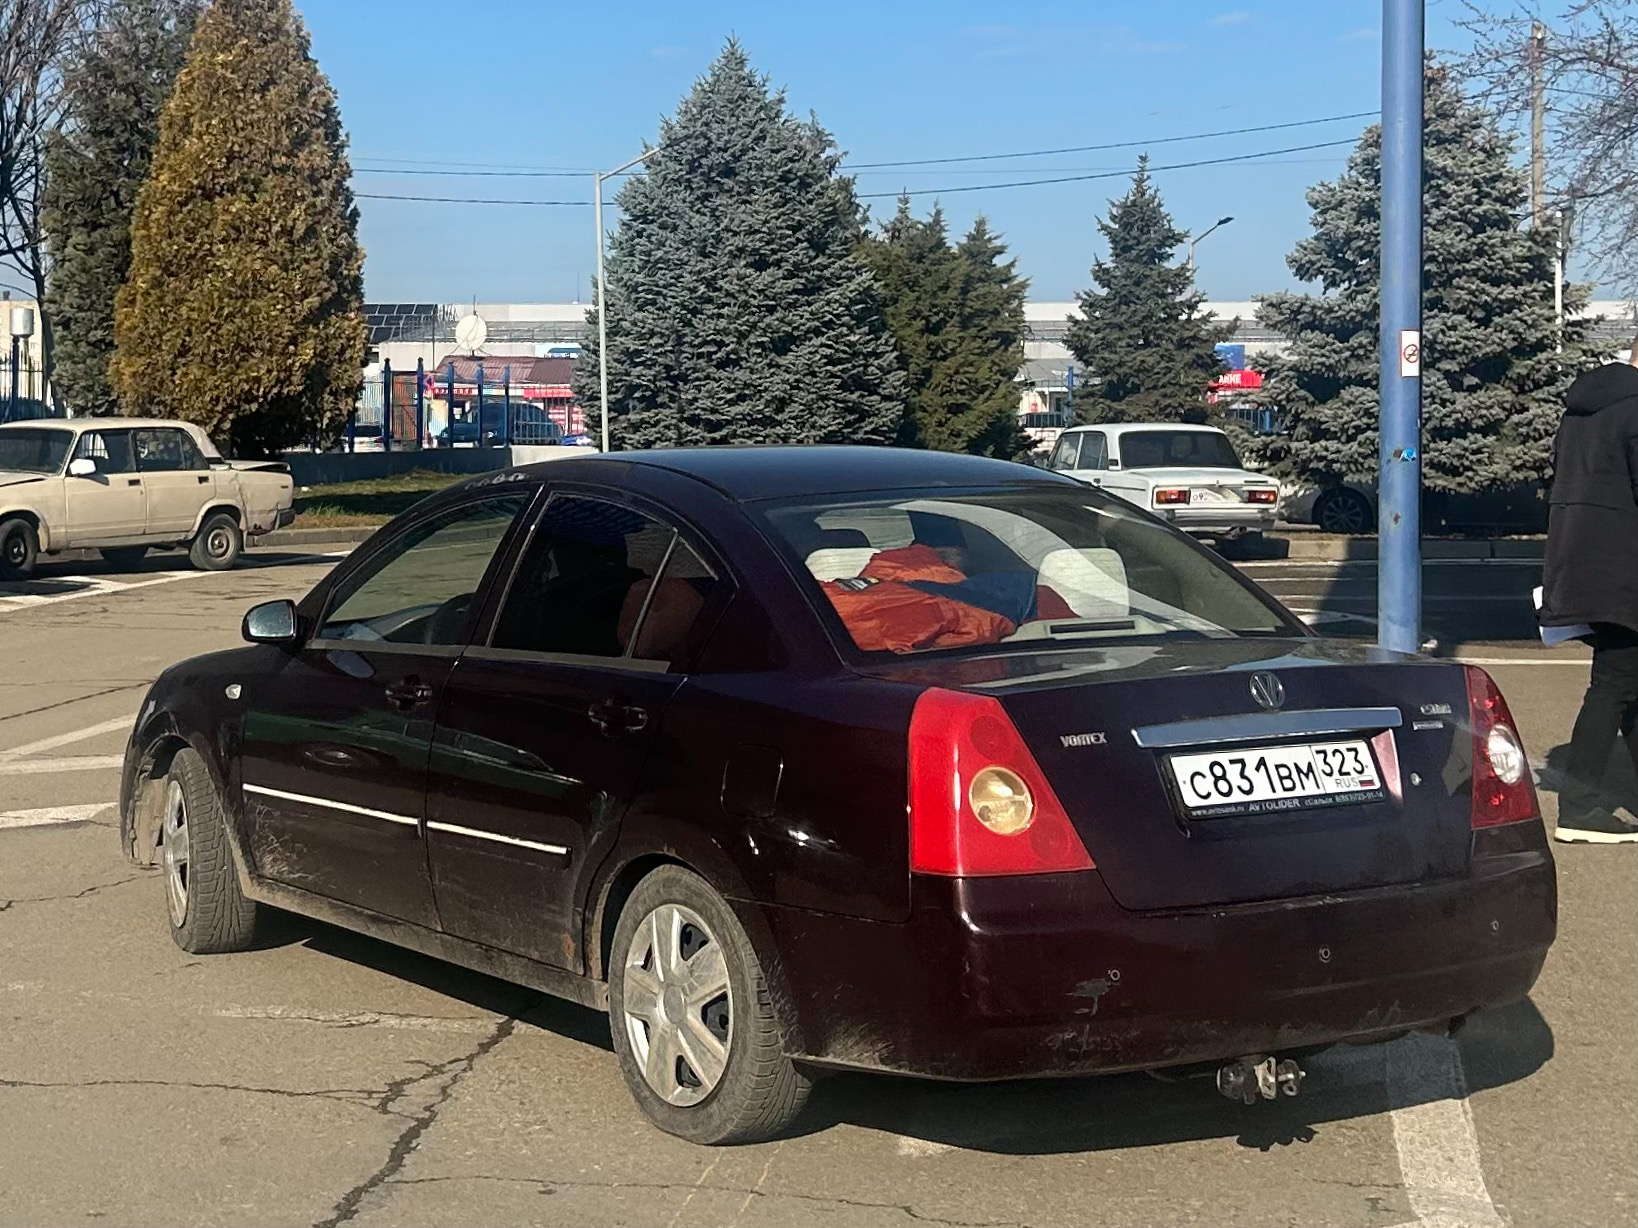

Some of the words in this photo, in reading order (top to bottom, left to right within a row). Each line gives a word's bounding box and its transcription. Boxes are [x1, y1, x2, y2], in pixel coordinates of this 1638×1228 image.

[1060, 732, 1107, 747] VORTEX
[1315, 747, 1364, 777] 323
[1334, 777, 1359, 788] RUS
